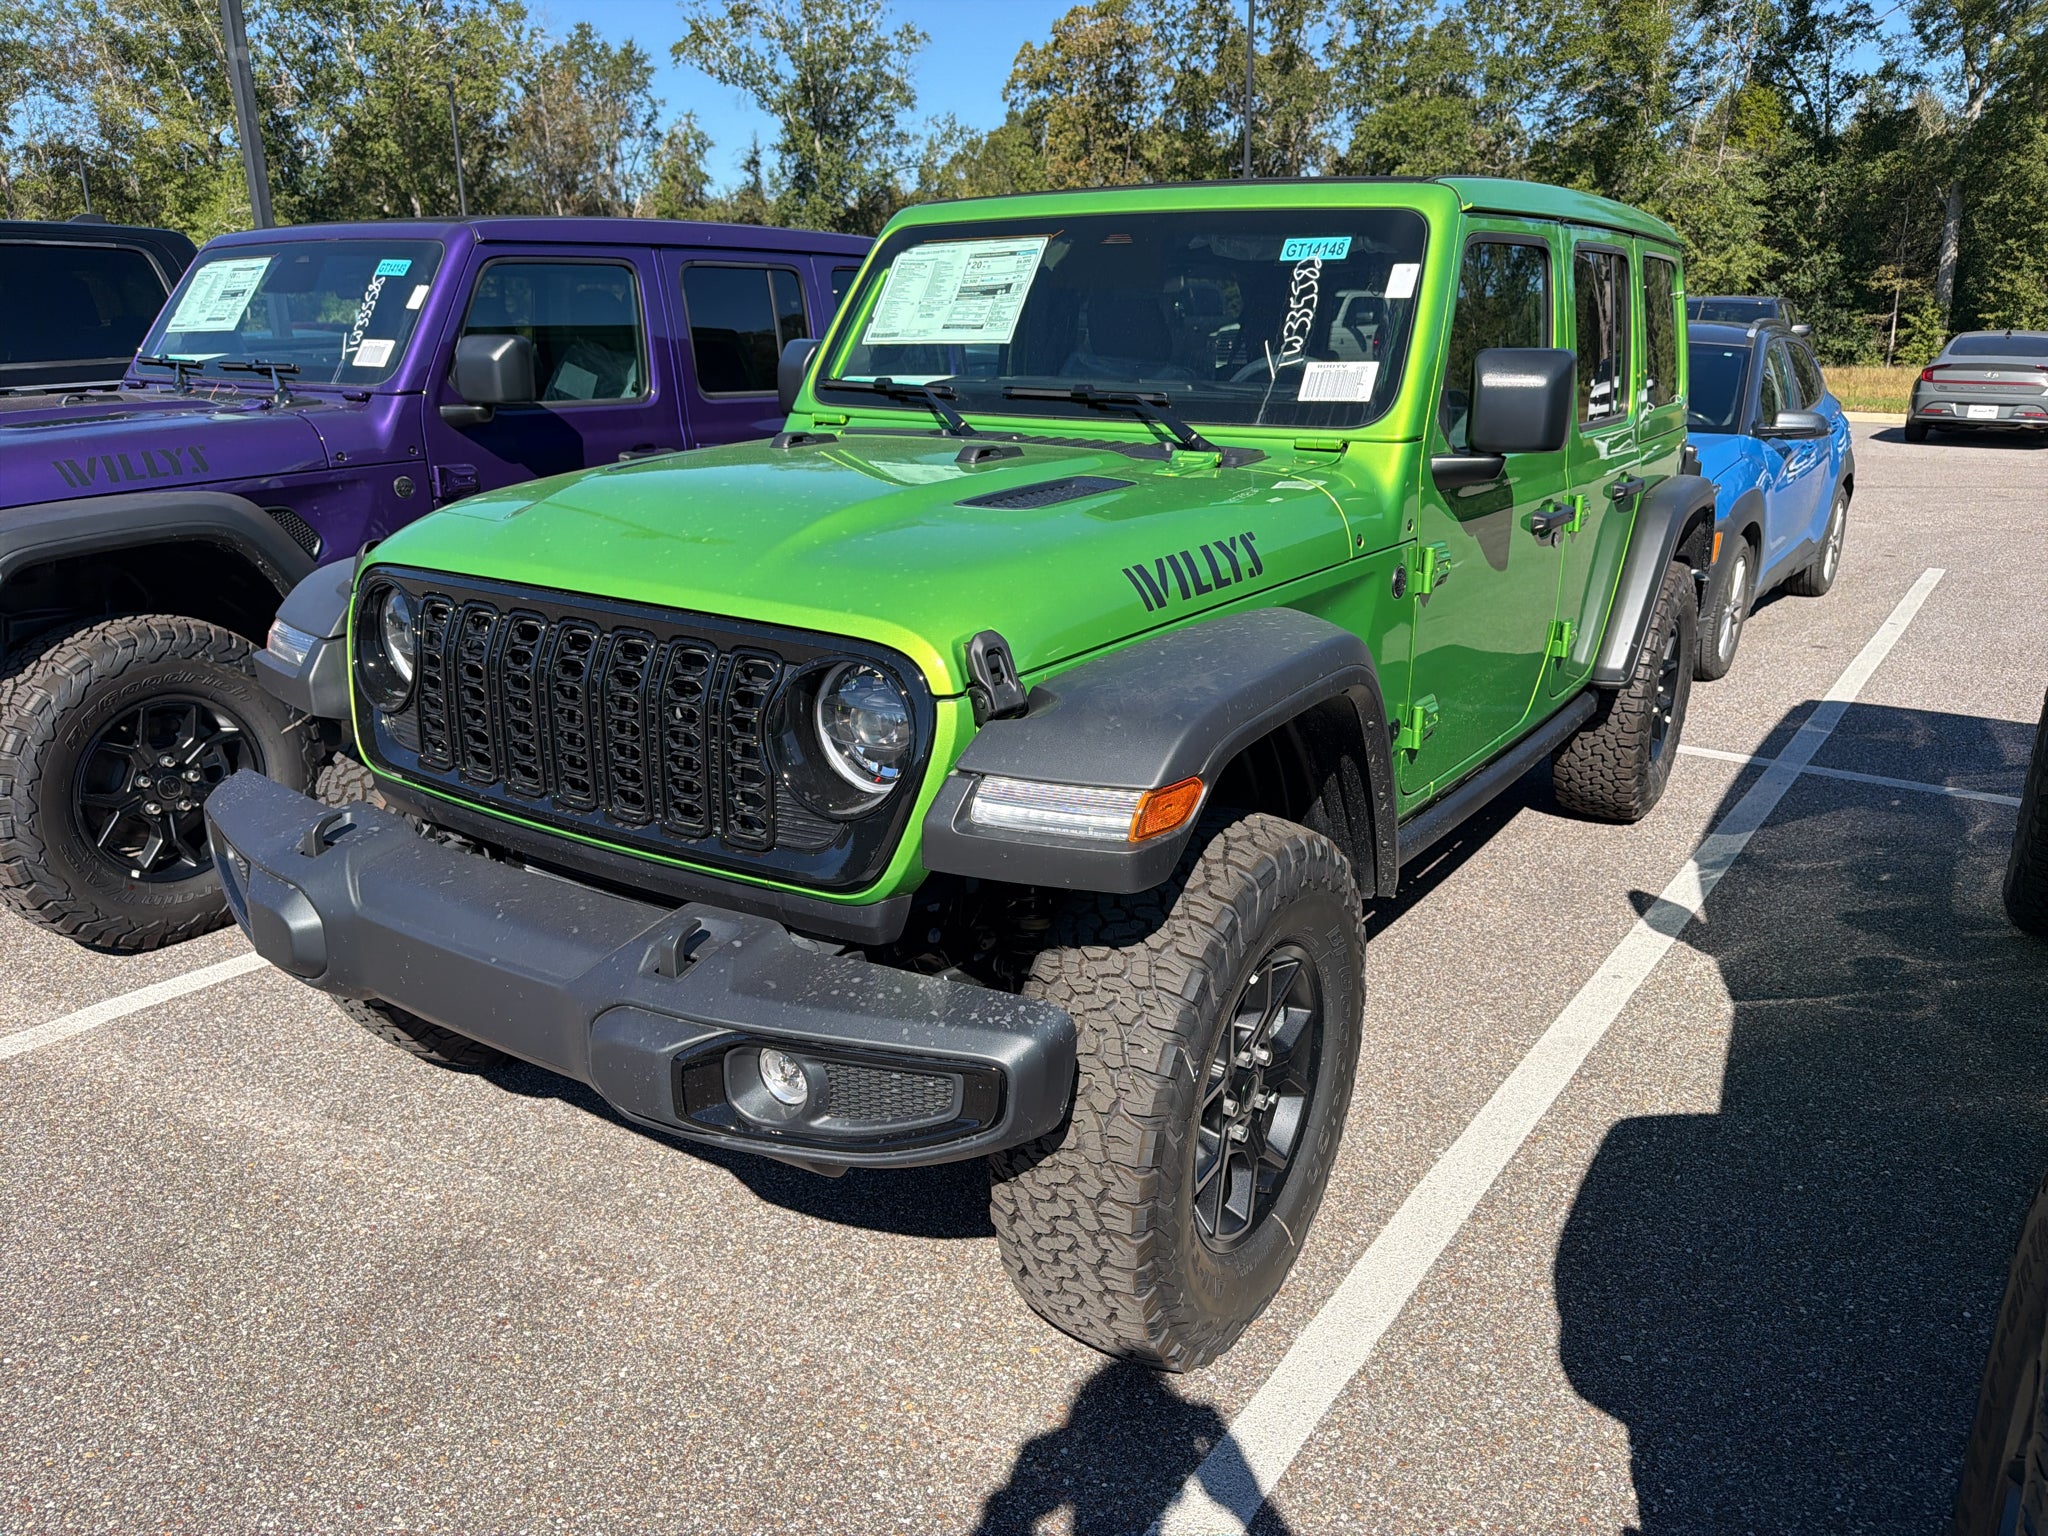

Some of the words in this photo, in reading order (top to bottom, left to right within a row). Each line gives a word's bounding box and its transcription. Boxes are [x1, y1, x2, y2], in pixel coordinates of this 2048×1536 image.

[1285, 241, 1345, 257] GT14148
[52, 445, 210, 488] WILLYS
[1121, 531, 1264, 612] WILLYS
